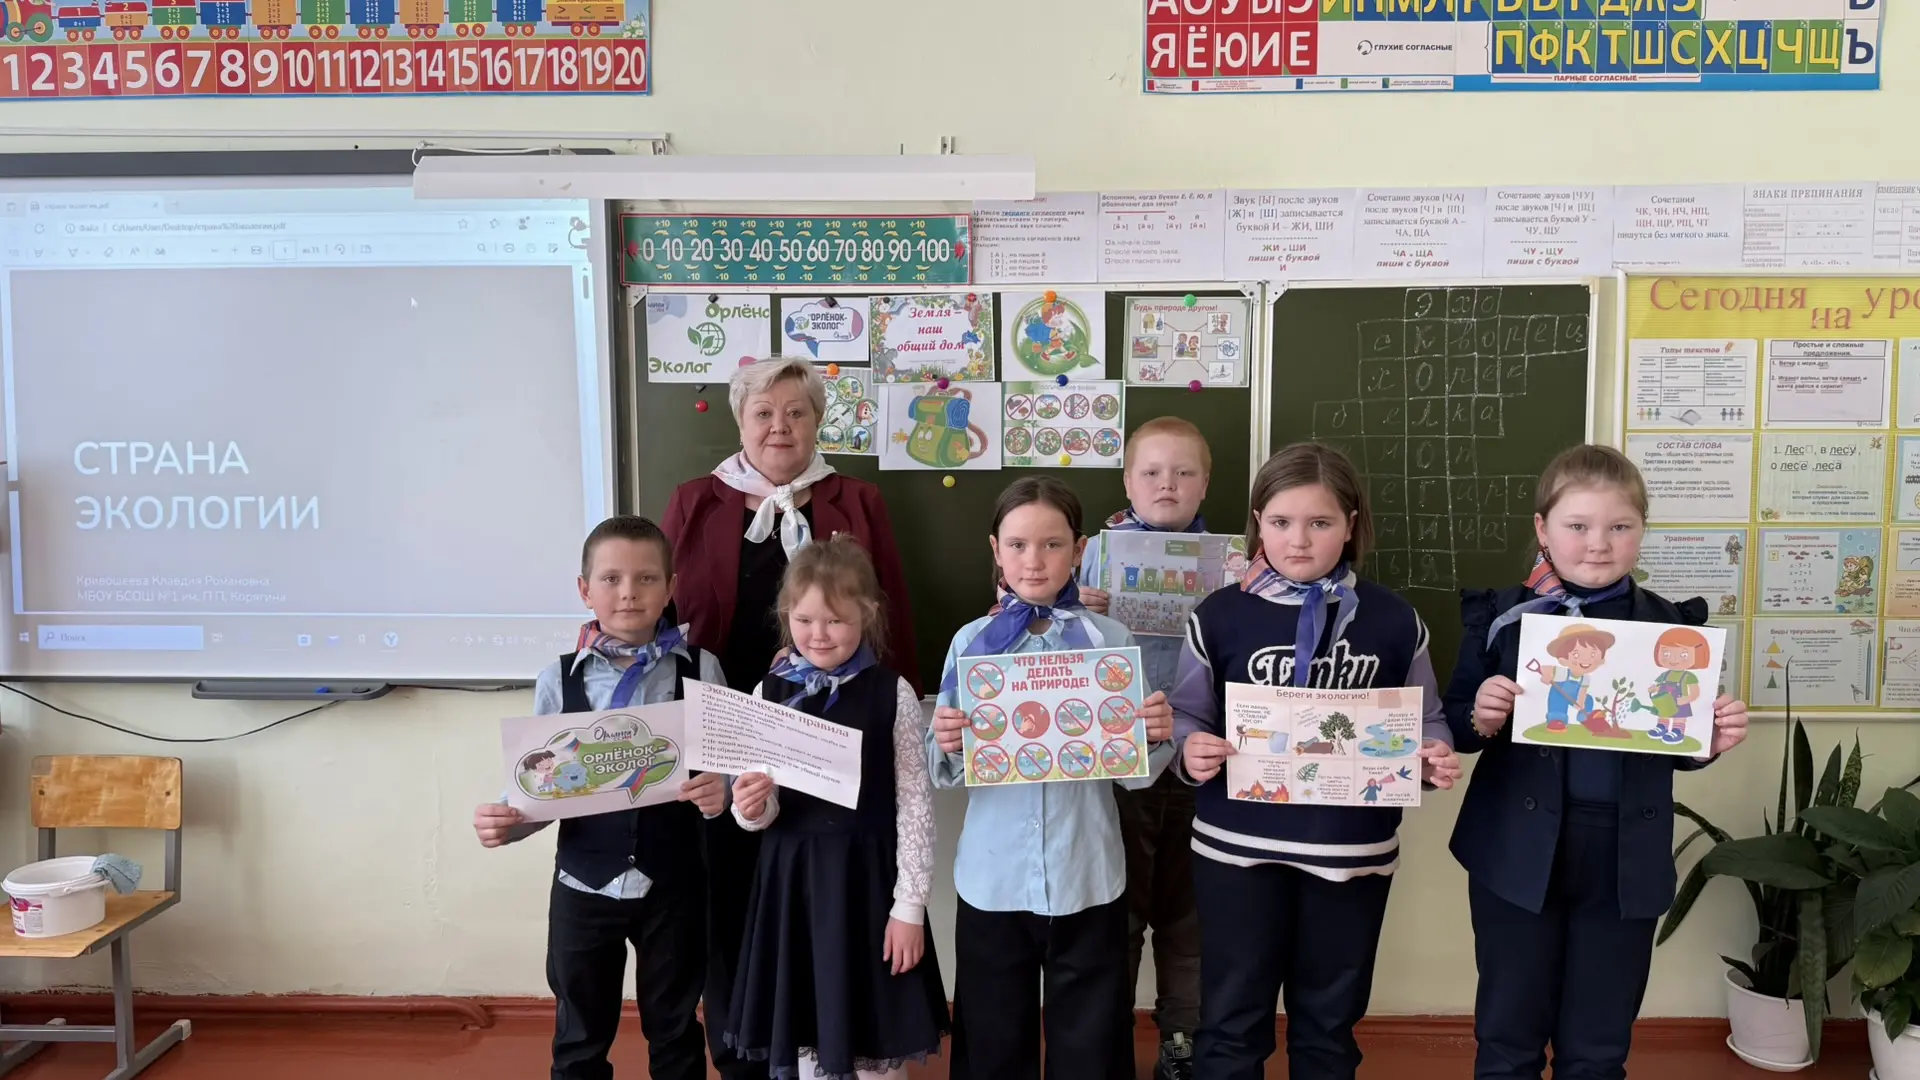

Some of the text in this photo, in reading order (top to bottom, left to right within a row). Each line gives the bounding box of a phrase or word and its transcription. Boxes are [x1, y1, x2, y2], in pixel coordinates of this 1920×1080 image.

[1374, 43, 1453, 53] ГЛУХИЕ СОГЛАСНЫЕ
[2, 46, 646, 91] 1 2 3 4 5 6 7 8 9 10 11 12 13 14 15 16 17 18 19 20
[1553, 74, 1637, 82] ПАРНЫЕ СОГЛАСНЫЕ
[1752, 188, 1787, 199] ЗНАКИ
[1791, 188, 1863, 199] ПРЕПИНАНИЯ
[1233, 195, 1255, 206] Звук
[1278, 197, 1305, 205] после
[1307, 196, 1339, 205] звуков
[1651, 195, 1695, 204] Сочетания
[1280, 209, 1343, 219] записывается
[655, 219, 925, 228] +10 +10 +10 +10 +10 +10 +10 +10 +10 +10
[1236, 221, 1270, 232] буквой
[1315, 222, 1334, 231] ШИ
[1617, 231, 1652, 240] пишутся
[1654, 229, 1668, 239] без
[1670, 230, 1703, 240] мягкого
[642, 238, 949, 262] 0 10 20 30 40 50 60 70 80 90 100
[1248, 253, 1320, 263] пиши буквой
[1545, 256, 1579, 266] буквой
[1376, 259, 1449, 269] пиши буквой
[1133, 303, 1219, 313] Будь природе другом!
[1650, 277, 1808, 312] Сегодня
[1811, 305, 1851, 331] на
[908, 307, 951, 319] Земля
[917, 326, 943, 335] наш
[897, 339, 965, 352] общий дом
[1660, 346, 1682, 354] Типы
[1793, 341, 1824, 350] Простые
[649, 357, 712, 373] Эколог
[73, 440, 250, 476] СТРАНА
[1780, 461, 1808, 471] лесе
[74, 495, 319, 530] ЭКОЛОГИИ
[76, 574, 270, 588] Кривошеева Клавдия Романовна
[77, 590, 112, 602] МБОУ
[230, 590, 286, 603] Корягина
[1770, 628, 1788, 636] Виды
[1013, 653, 1084, 667] ЧТО НЕЛЬЗЯ
[1026, 665, 1073, 680] ДЕЛАТЬ
[1012, 677, 1090, 692] НА ПРИРОДЕ!
[1276, 689, 1370, 701] Береги экологию!
[702, 683, 849, 738] Экологические правила
[583, 744, 655, 765] ОРЛЁНОК
[594, 756, 656, 775] ЭКОЛОГ
